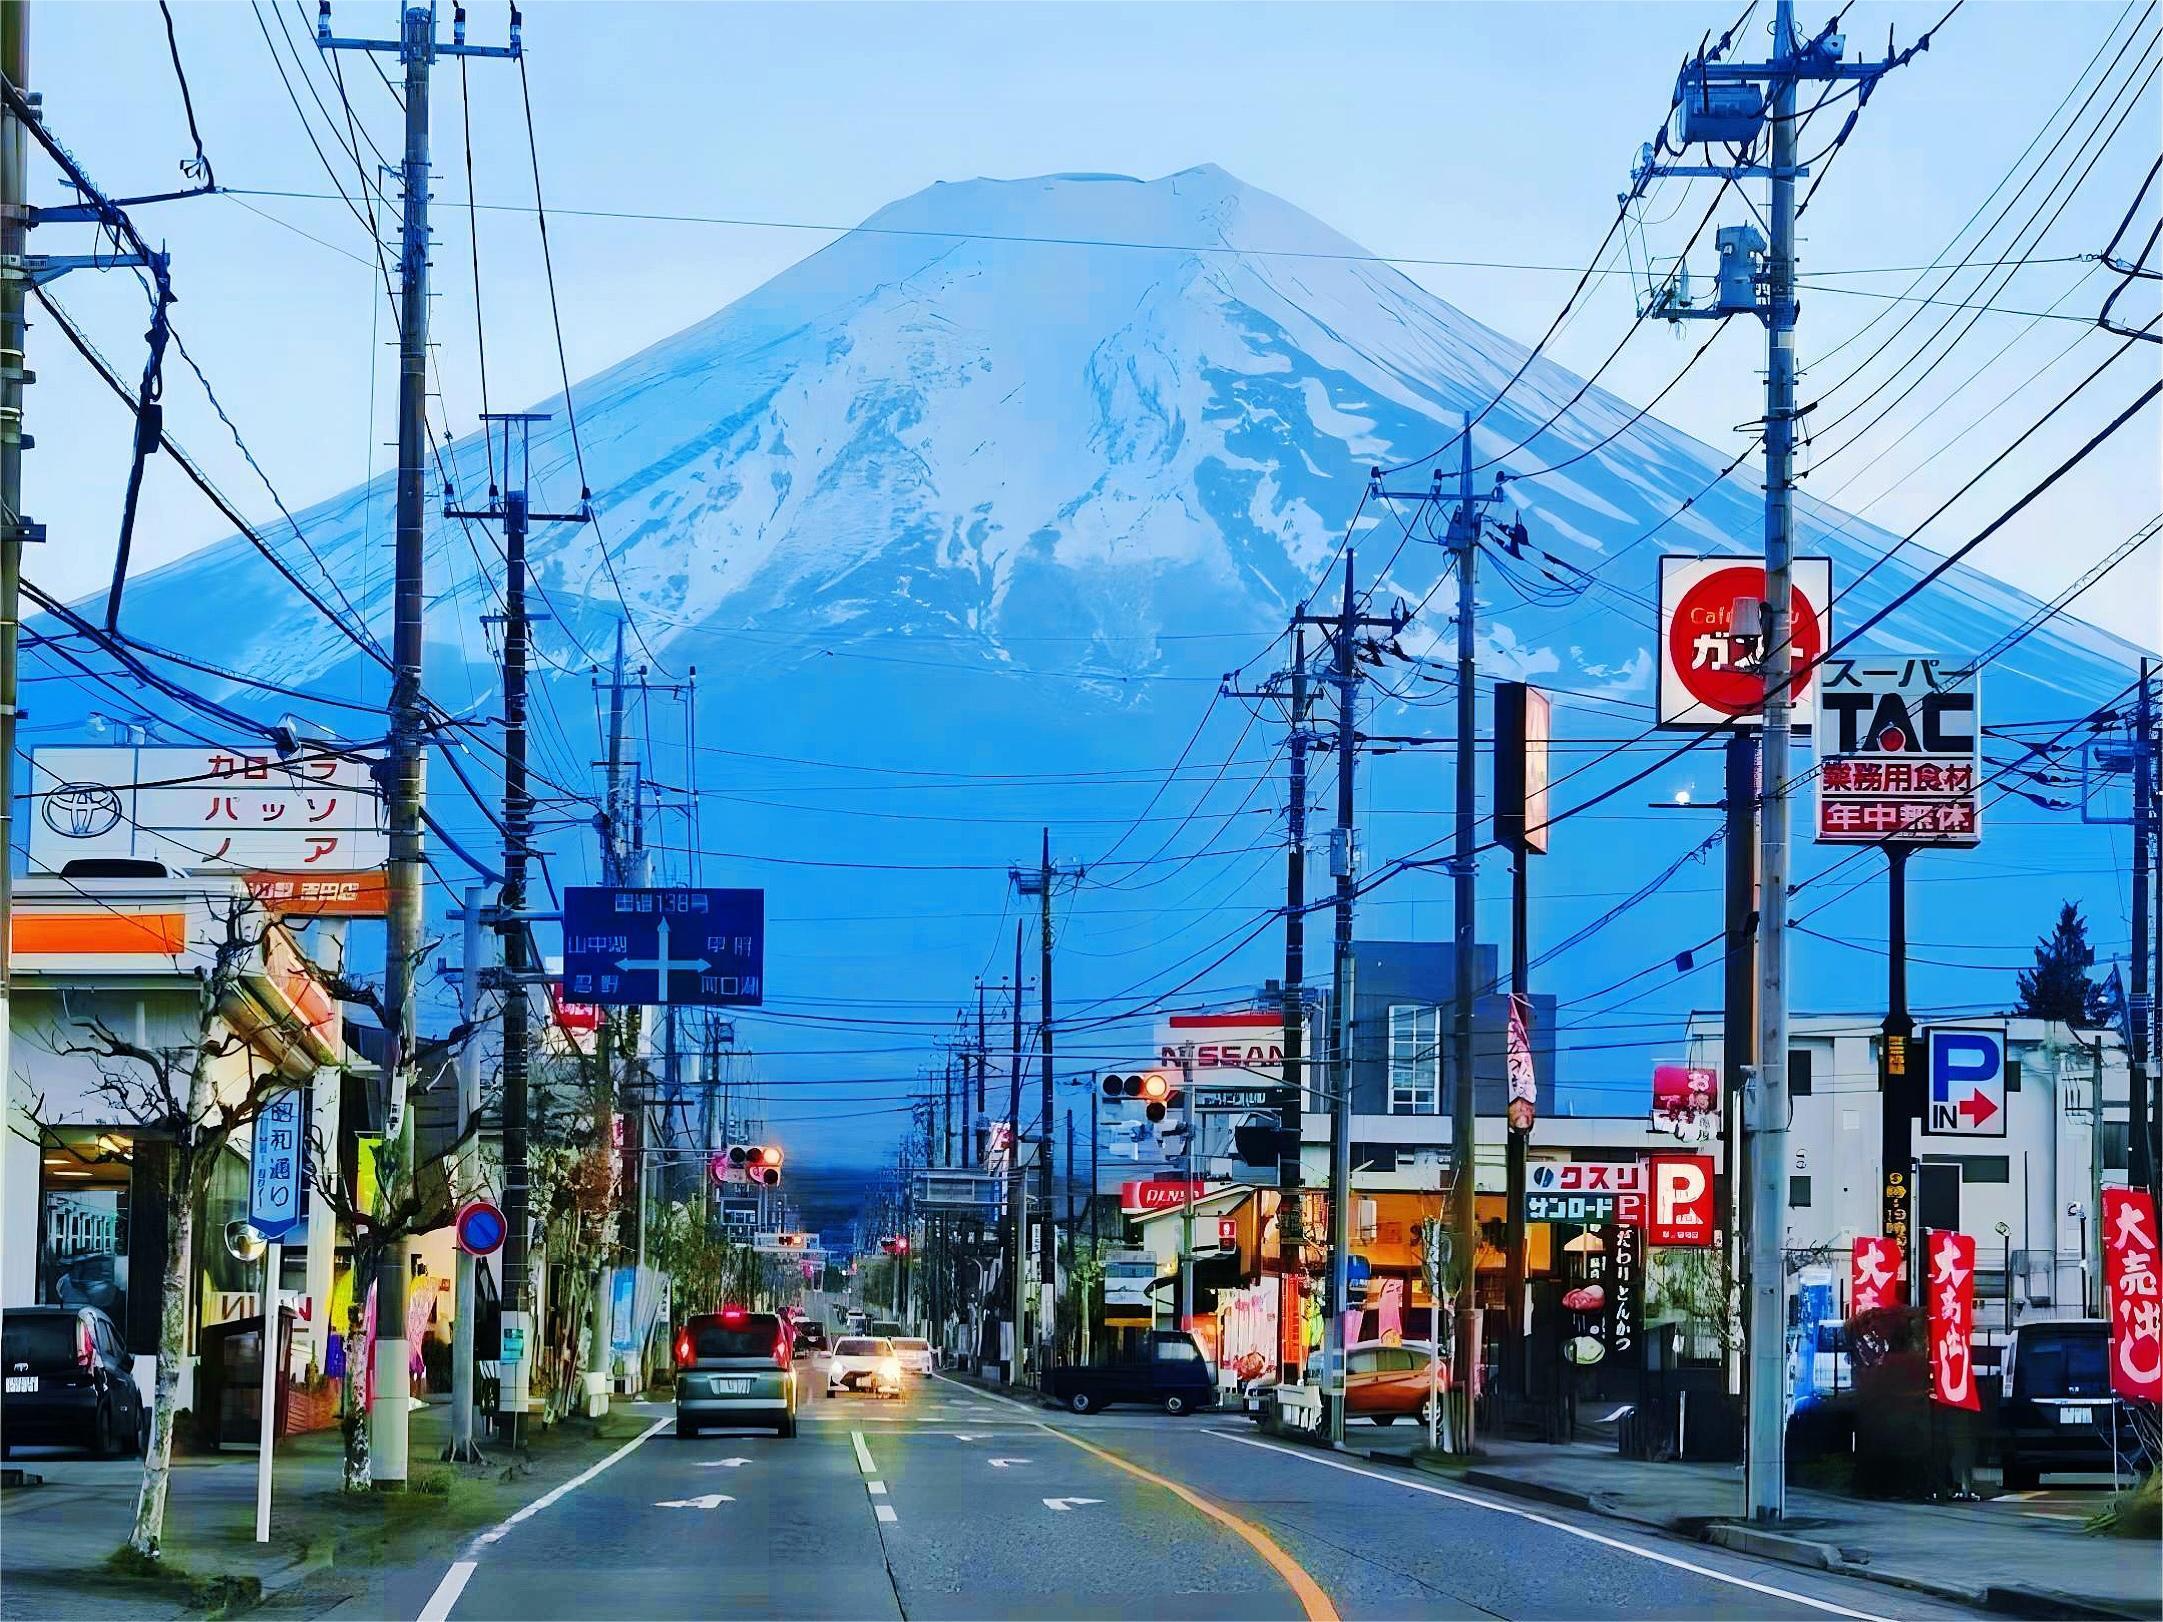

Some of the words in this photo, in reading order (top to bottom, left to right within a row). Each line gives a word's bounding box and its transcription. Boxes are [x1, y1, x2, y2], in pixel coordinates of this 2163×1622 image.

[1822, 659, 1973, 689] スーパー
[1822, 692, 1974, 753] TAC
[208, 755, 337, 780] カロラ
[1822, 763, 1973, 792] 業務用食材
[205, 797, 337, 823] パッソ
[1827, 803, 1969, 831] 年中無休
[1933, 1035, 2000, 1103] P
[1933, 1104, 1957, 1129] IN
[1560, 1166, 1639, 1190] クスリ
[1528, 1197, 1613, 1220] サンロード
[1657, 1163, 1705, 1225] P
[1616, 1224, 1634, 1351] だわりとんかつ
[2113, 1202, 2161, 1384] 大売出し
